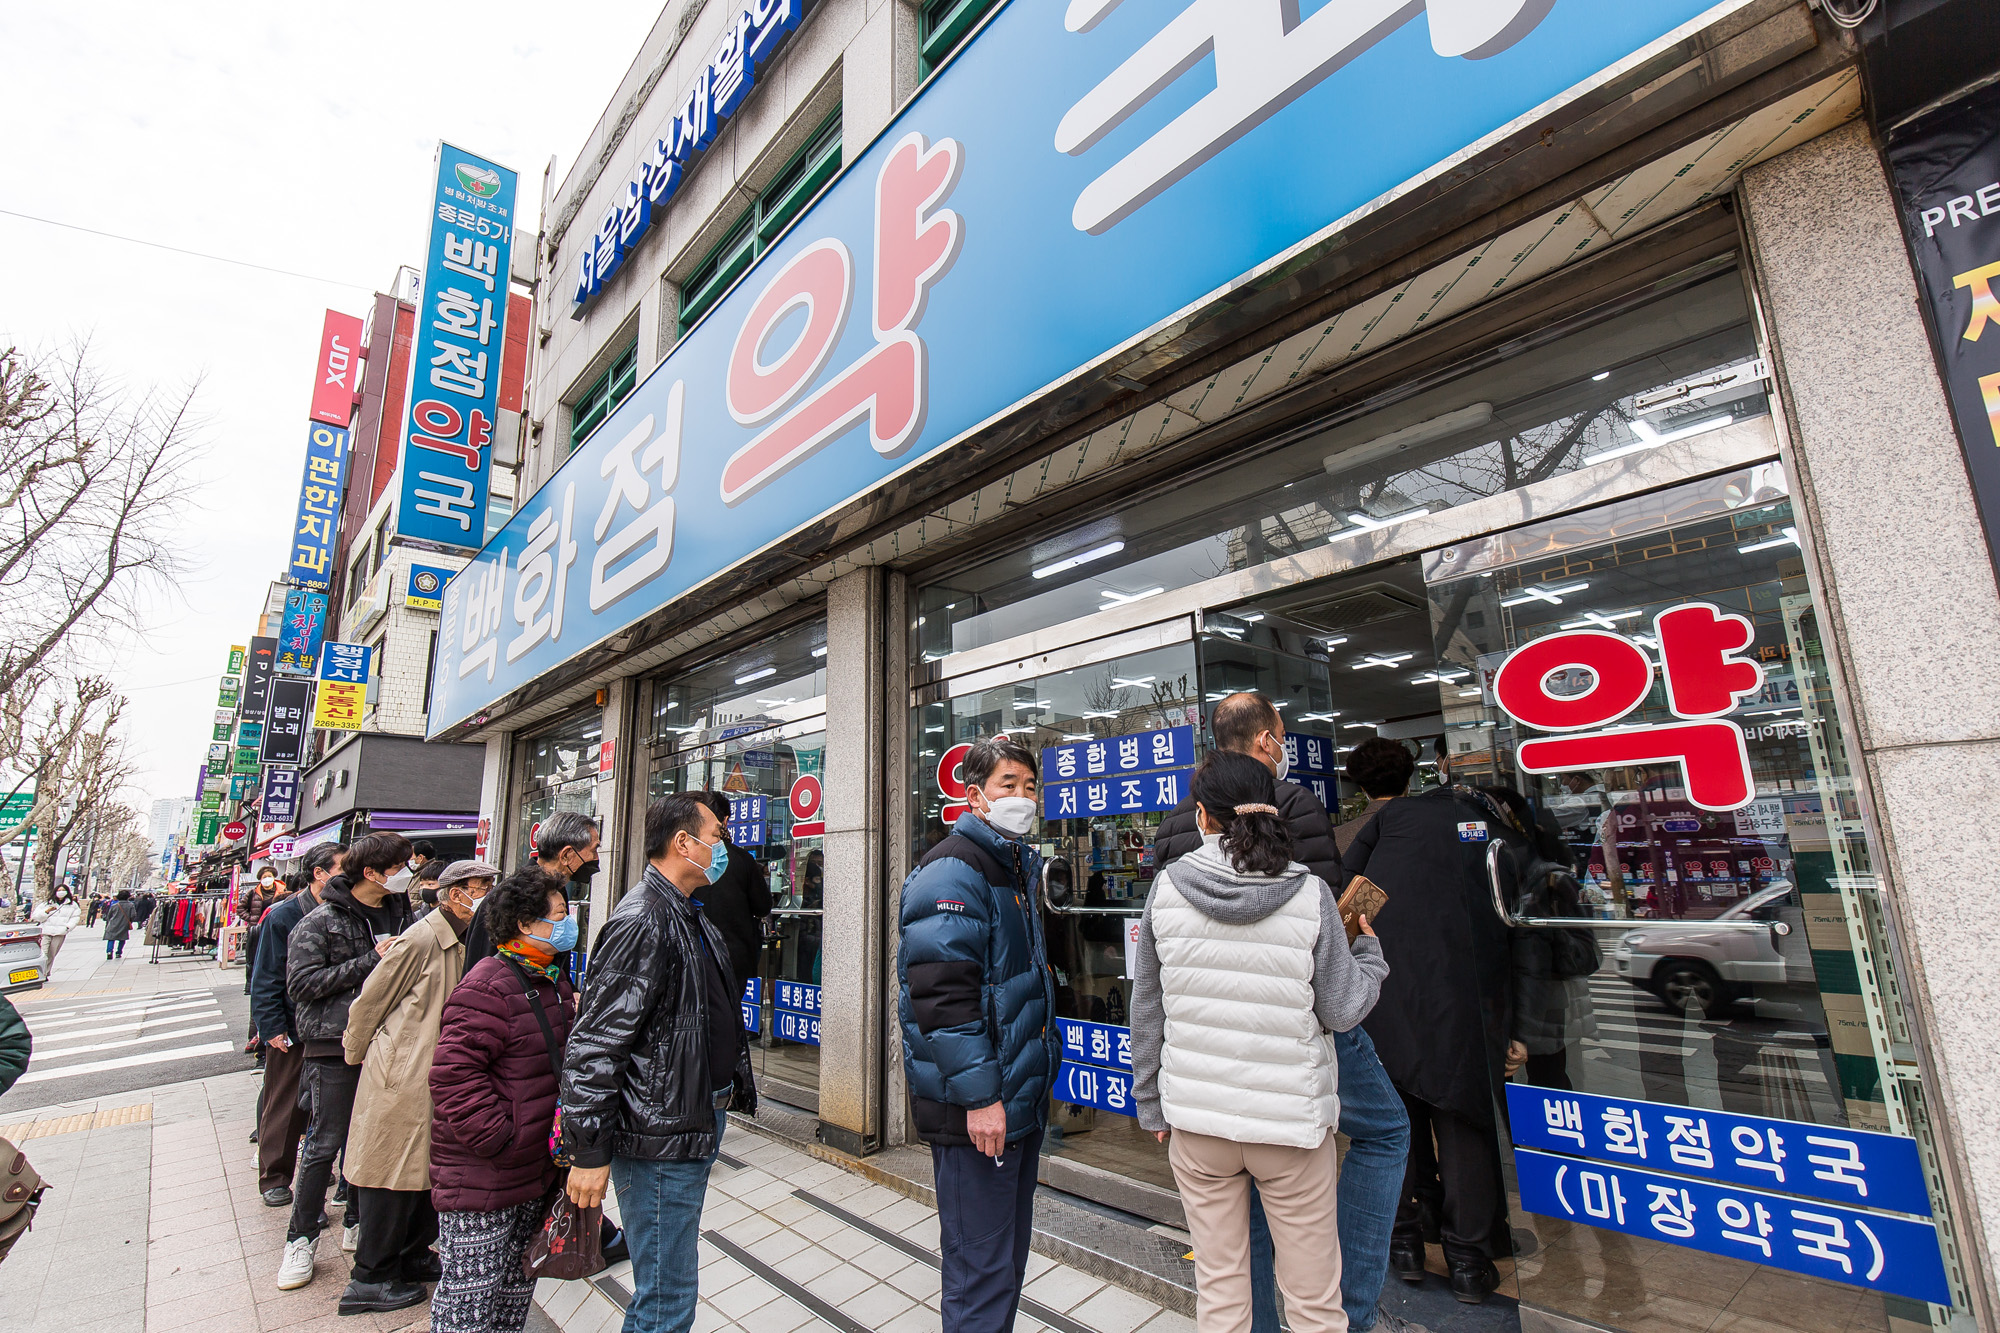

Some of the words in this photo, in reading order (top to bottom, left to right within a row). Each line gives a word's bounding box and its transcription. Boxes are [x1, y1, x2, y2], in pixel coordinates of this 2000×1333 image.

[438, 201, 510, 244] 종로5가
[327, 335, 350, 390] JDX
[292, 427, 346, 576] 이편한치과
[288, 593, 326, 614] 키움
[289, 614, 318, 655] 참치
[280, 651, 315, 669] 초밥
[327, 643, 364, 682] 행정사
[432, 580, 462, 729] 종로5가
[273, 706, 302, 720] 벨라
[323, 682, 360, 720] 부동산
[1493, 602, 1766, 812] 약
[270, 722, 299, 736] 노래
[315, 719, 361, 730] 2269-3357
[1058, 731, 1175, 778] 종합병원
[1284, 736, 1323, 770] 병원
[268, 770, 295, 815] 고시텔
[1059, 774, 1178, 815] 처방조제
[261, 814, 293, 823] 2263-6033
[1461, 830, 1485, 838] 당기세요
[936, 901, 965, 913] MILLET
[782, 985, 821, 1010] 백화점
[780, 1013, 821, 1044] (마장약
[1067, 1027, 1131, 1066] 백화점
[1068, 1063, 1131, 1108] (마장
[1543, 1097, 1870, 1198] 백화점약국
[1554, 1163, 1886, 1283] (마장약국)
